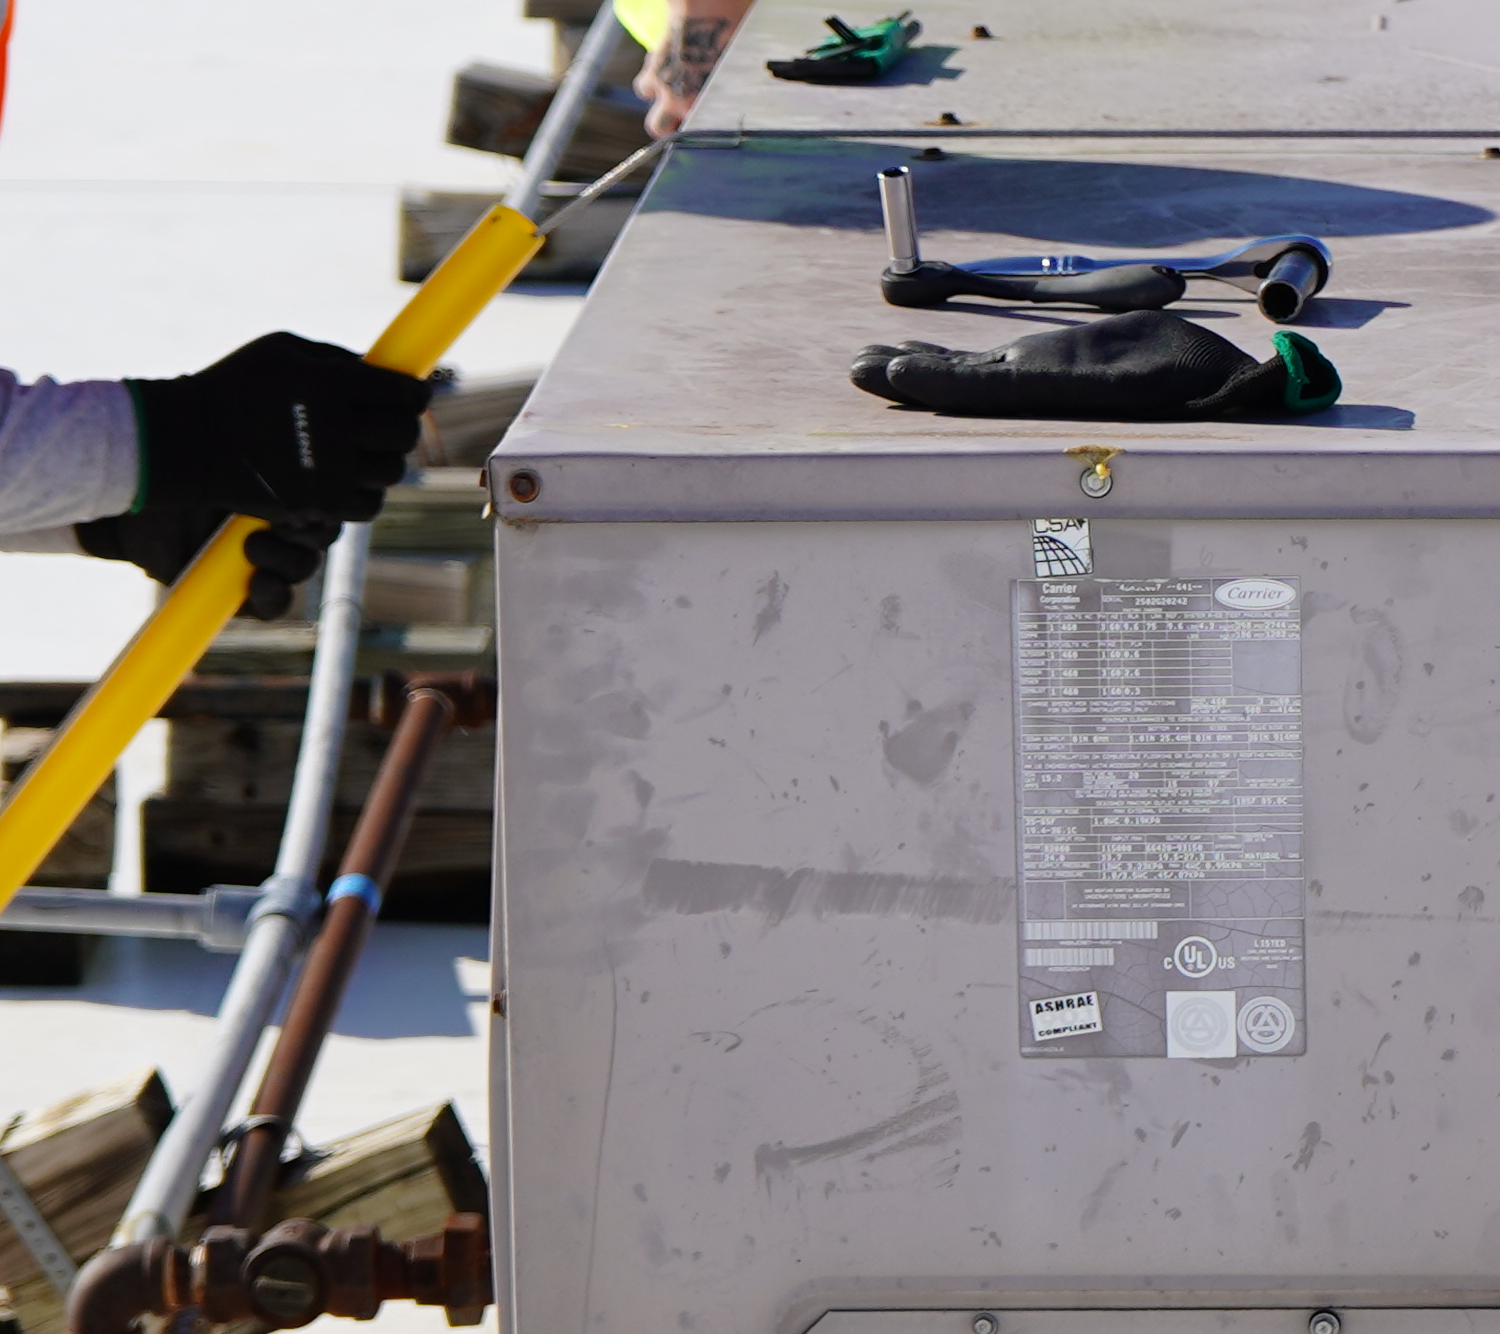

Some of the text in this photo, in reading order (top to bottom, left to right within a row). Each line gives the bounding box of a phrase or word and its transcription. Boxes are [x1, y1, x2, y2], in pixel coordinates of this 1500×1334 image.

[1041, 583, 1078, 594] Carrier
[1227, 587, 1285, 599] Carrier
[1163, 956, 1174, 970] C
[1217, 956, 1237, 969] US
[1035, 994, 1095, 1015] ASHRAE
[1038, 1021, 1098, 1037] COMPLIANT
